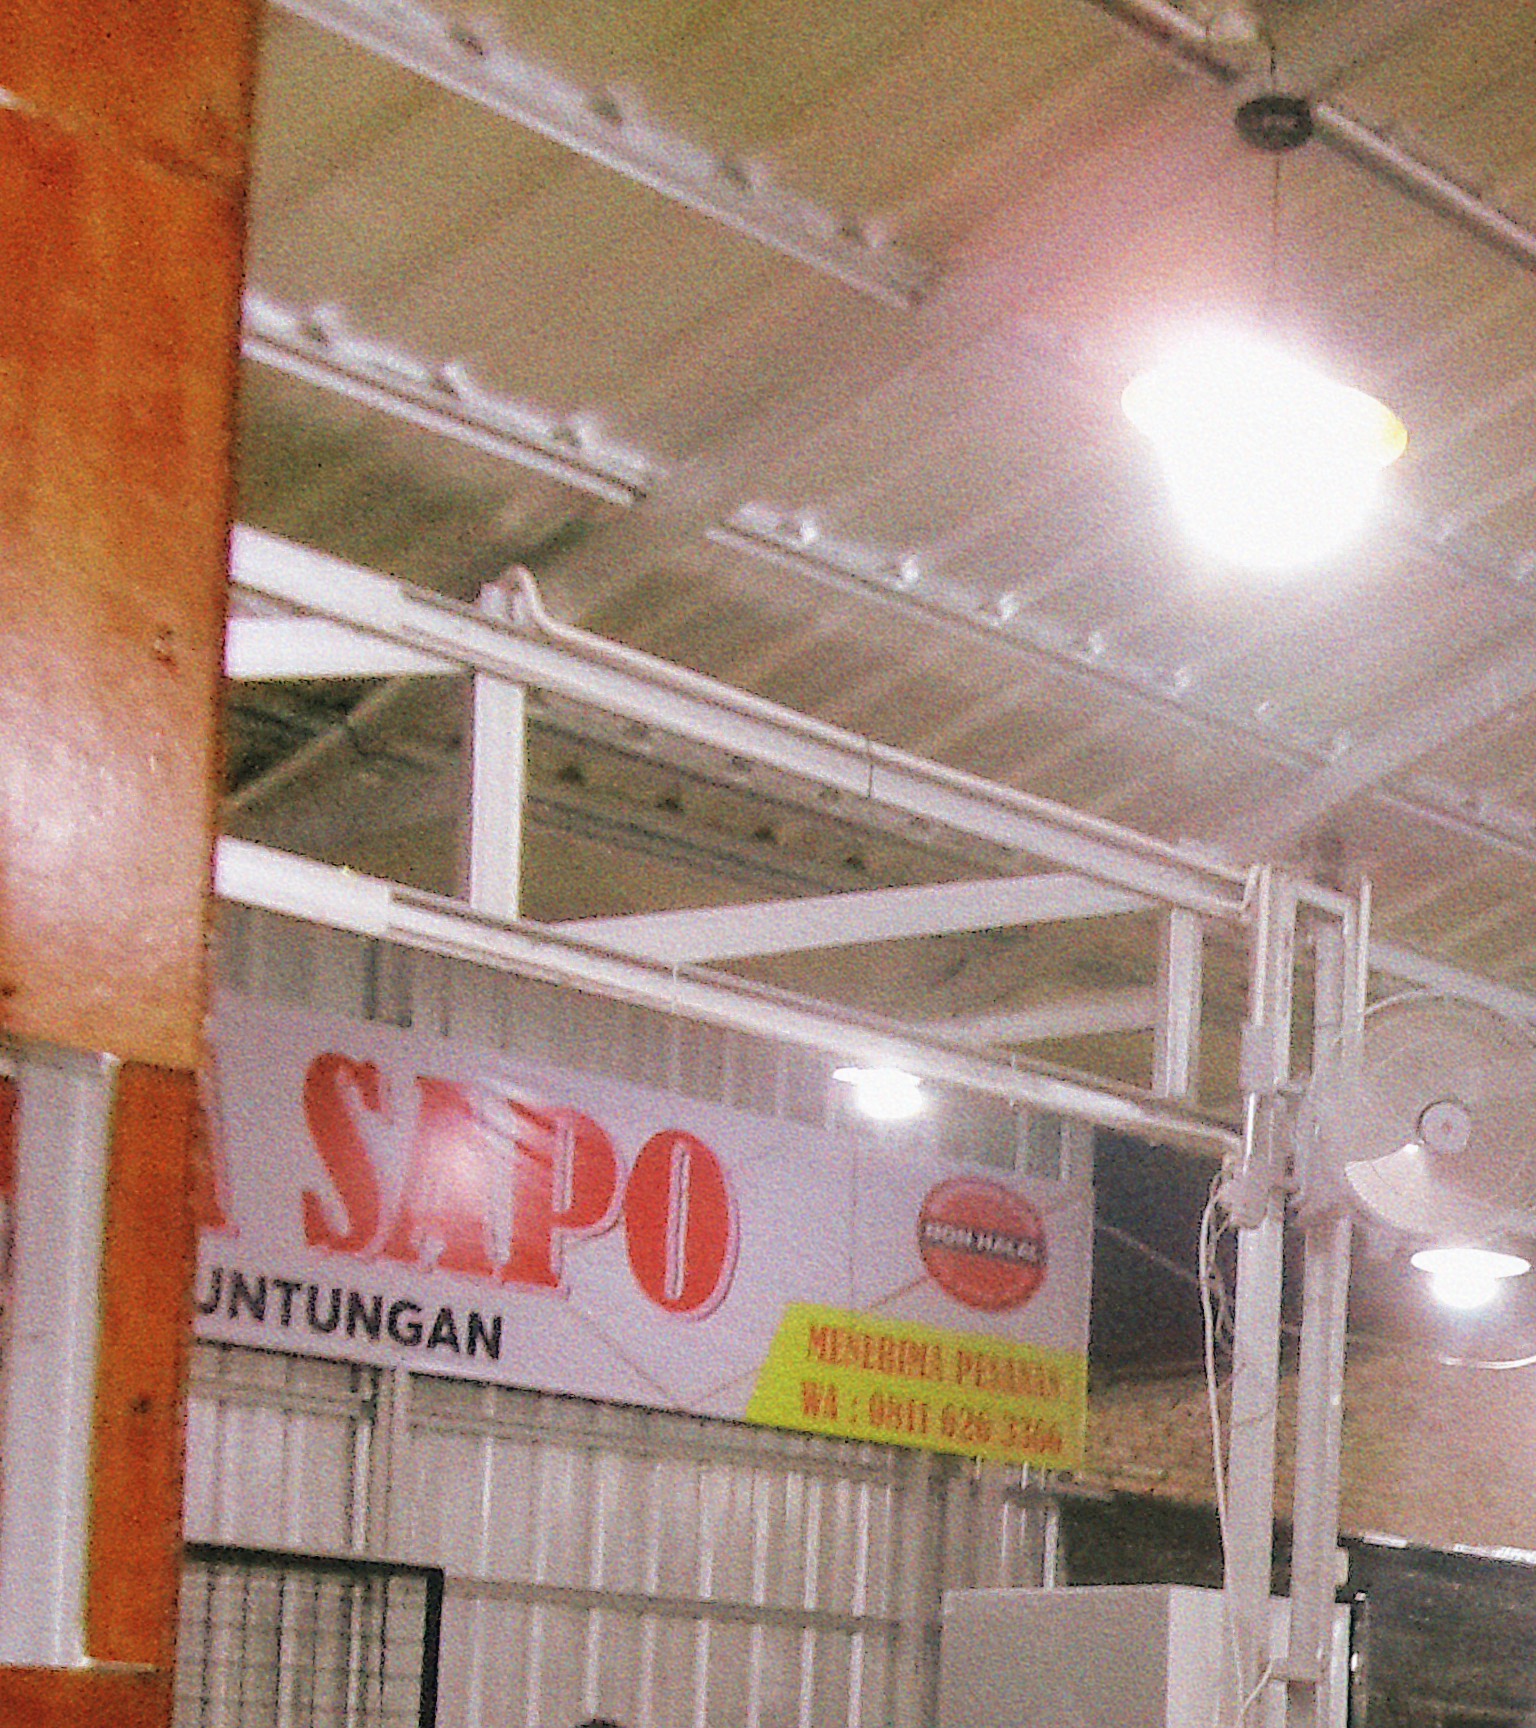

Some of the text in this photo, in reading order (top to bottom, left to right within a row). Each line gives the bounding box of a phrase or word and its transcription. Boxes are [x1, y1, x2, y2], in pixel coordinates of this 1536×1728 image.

[302, 1052, 740, 1318] SAPO
[197, 1266, 504, 1362] UNTUNGAN
[808, 1324, 944, 1382] MENERIMA
[801, 1380, 838, 1418] WA
